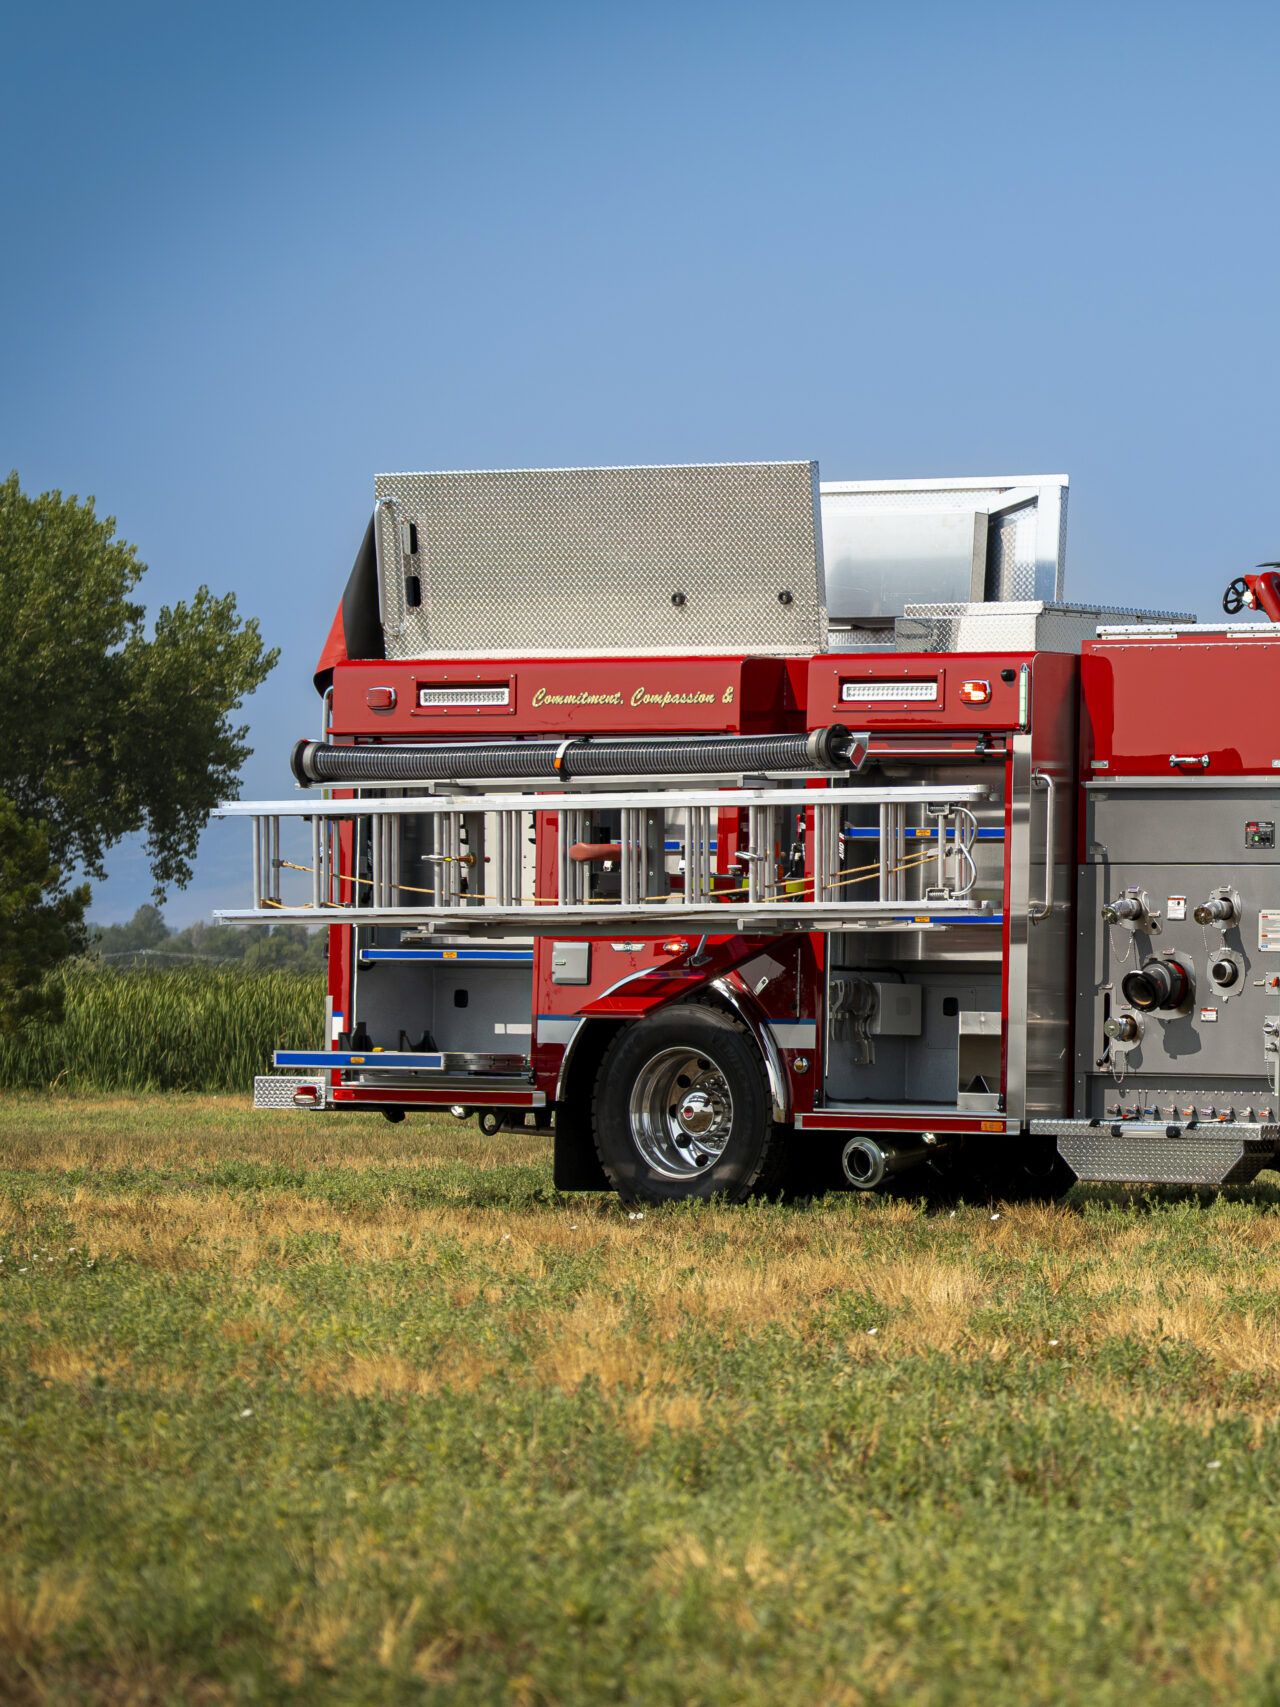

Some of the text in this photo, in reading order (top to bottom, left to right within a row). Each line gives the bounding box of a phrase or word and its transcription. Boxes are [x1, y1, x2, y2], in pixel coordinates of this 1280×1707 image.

[531, 685, 734, 708] Commitment, Compassion &
